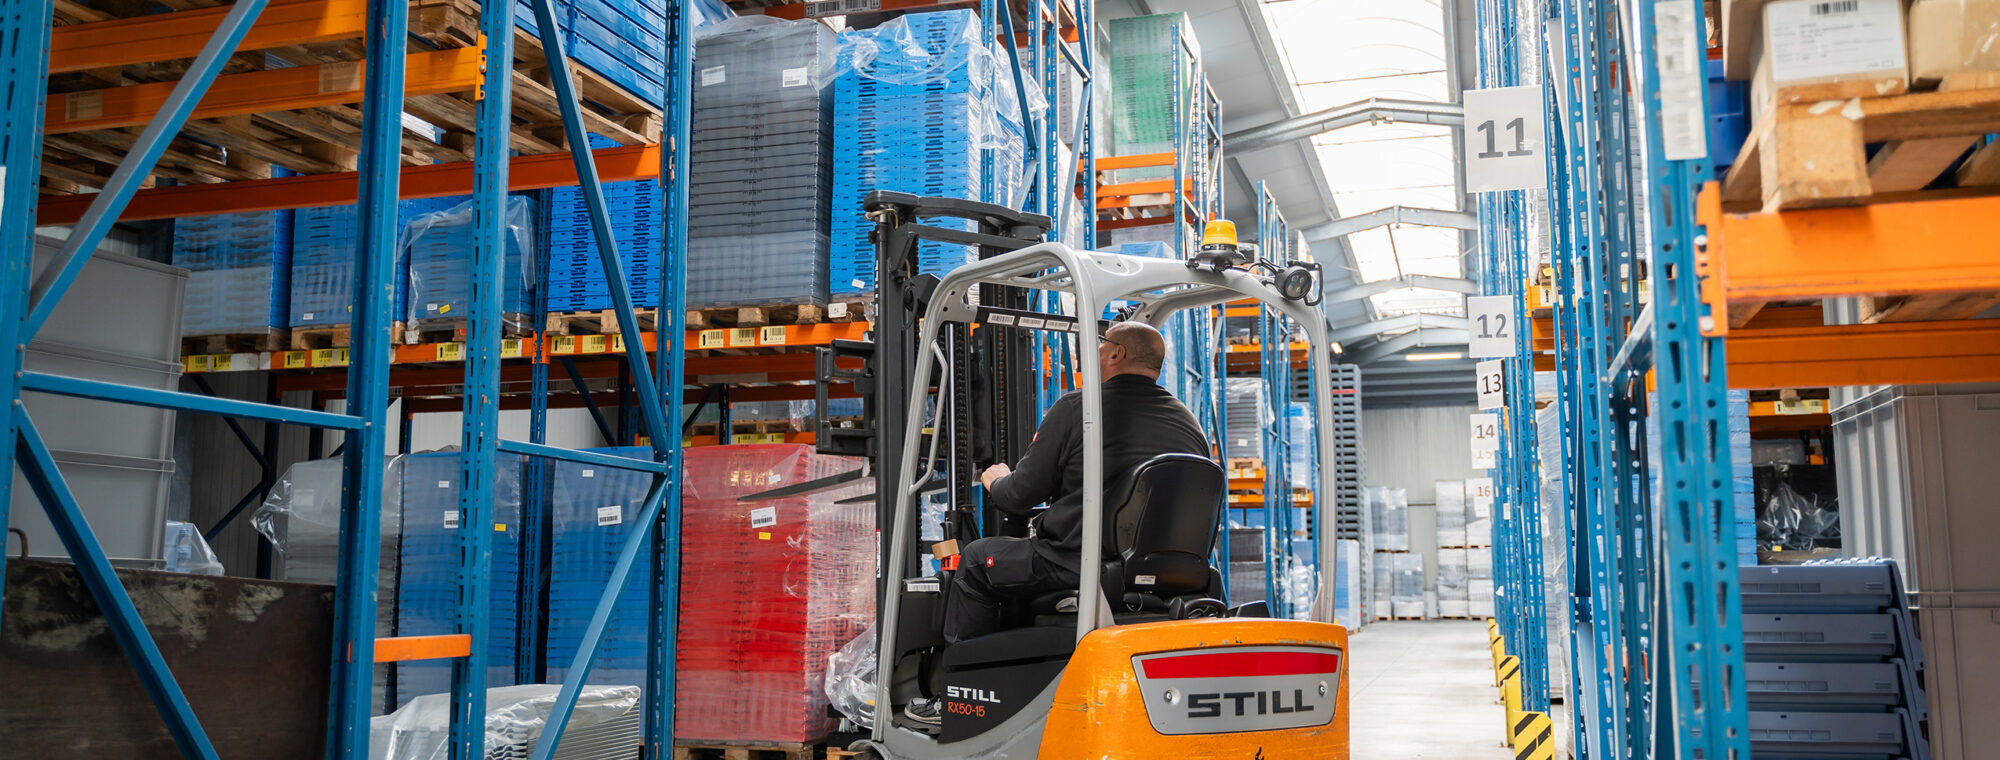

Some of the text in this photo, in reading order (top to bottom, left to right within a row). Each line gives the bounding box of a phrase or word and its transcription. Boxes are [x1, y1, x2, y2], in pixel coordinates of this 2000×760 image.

[1477, 117, 1533, 158] 11
[1477, 313, 1508, 338] 12
[1481, 373, 1502, 395] 13
[1476, 424, 1495, 439] 14
[1477, 486, 1491, 497] 16
[947, 685, 1001, 704] STILL
[1188, 689, 1315, 719] STILL
[947, 701, 986, 718] RX50-15
